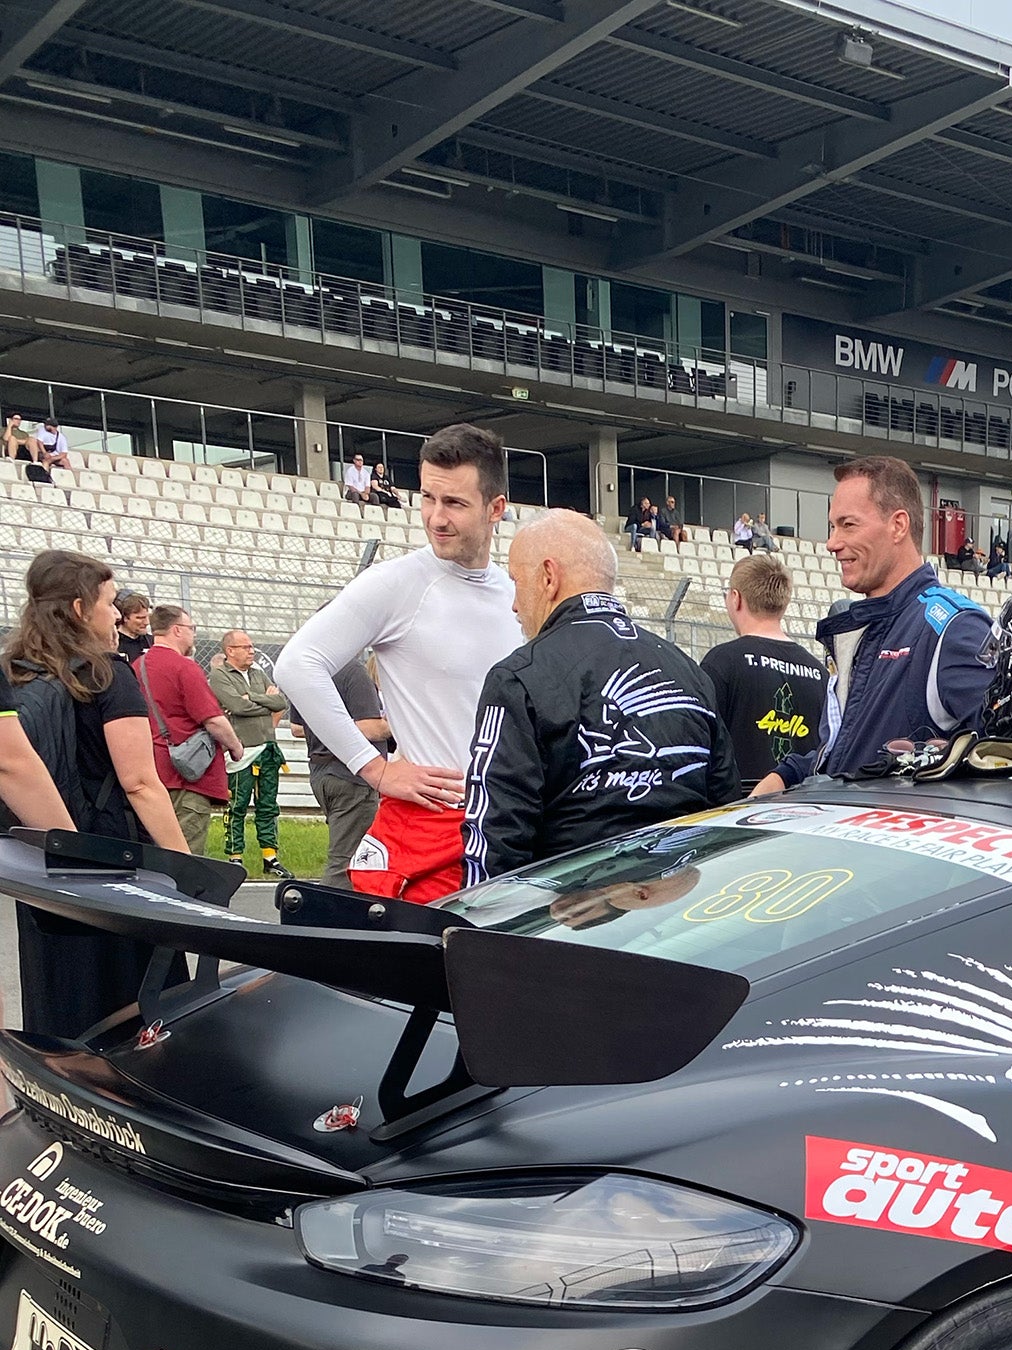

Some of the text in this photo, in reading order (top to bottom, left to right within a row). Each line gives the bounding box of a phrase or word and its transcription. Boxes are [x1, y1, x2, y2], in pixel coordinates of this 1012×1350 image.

[835, 334, 904, 377] BMW
[929, 604, 949, 623] OMP
[744, 653, 822, 681] T. PREINING
[572, 768, 663, 801] it's magic
[890, 838, 920, 848] IS
[911, 843, 967, 859] FAIR
[683, 868, 855, 923] 80
[60, 1092, 147, 1155] Osnabrück
[839, 1148, 970, 1190] sport
[55, 1177, 104, 1213] ingenieur
[72, 1206, 107, 1235] buero
